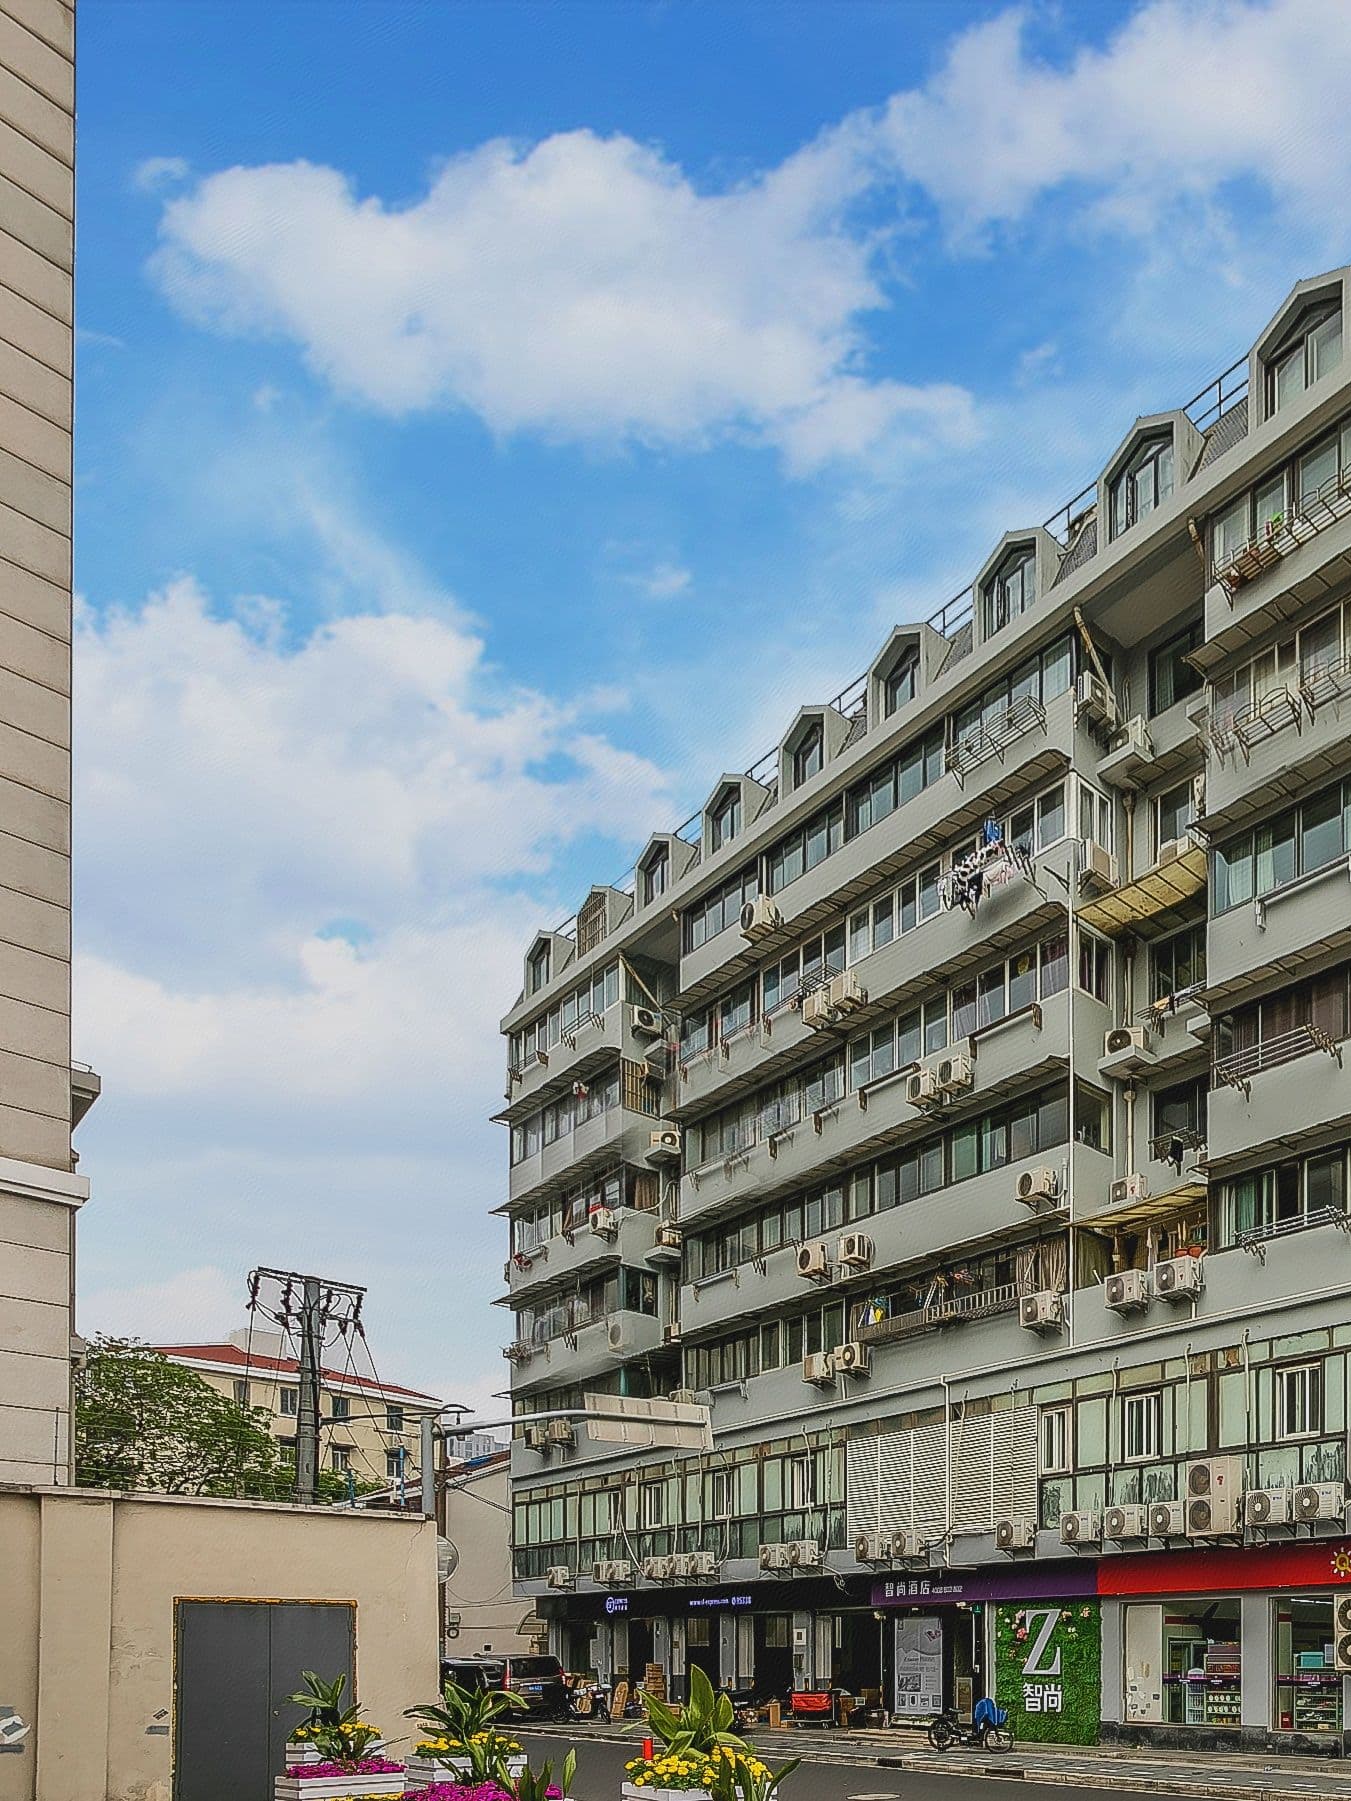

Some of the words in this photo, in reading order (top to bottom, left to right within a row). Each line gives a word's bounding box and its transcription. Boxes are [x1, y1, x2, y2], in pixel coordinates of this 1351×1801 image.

[885, 1580, 931, 1597] 智尚酒店
[1022, 1609, 1061, 1674] Z
[1023, 1682, 1062, 1713] 智尚
